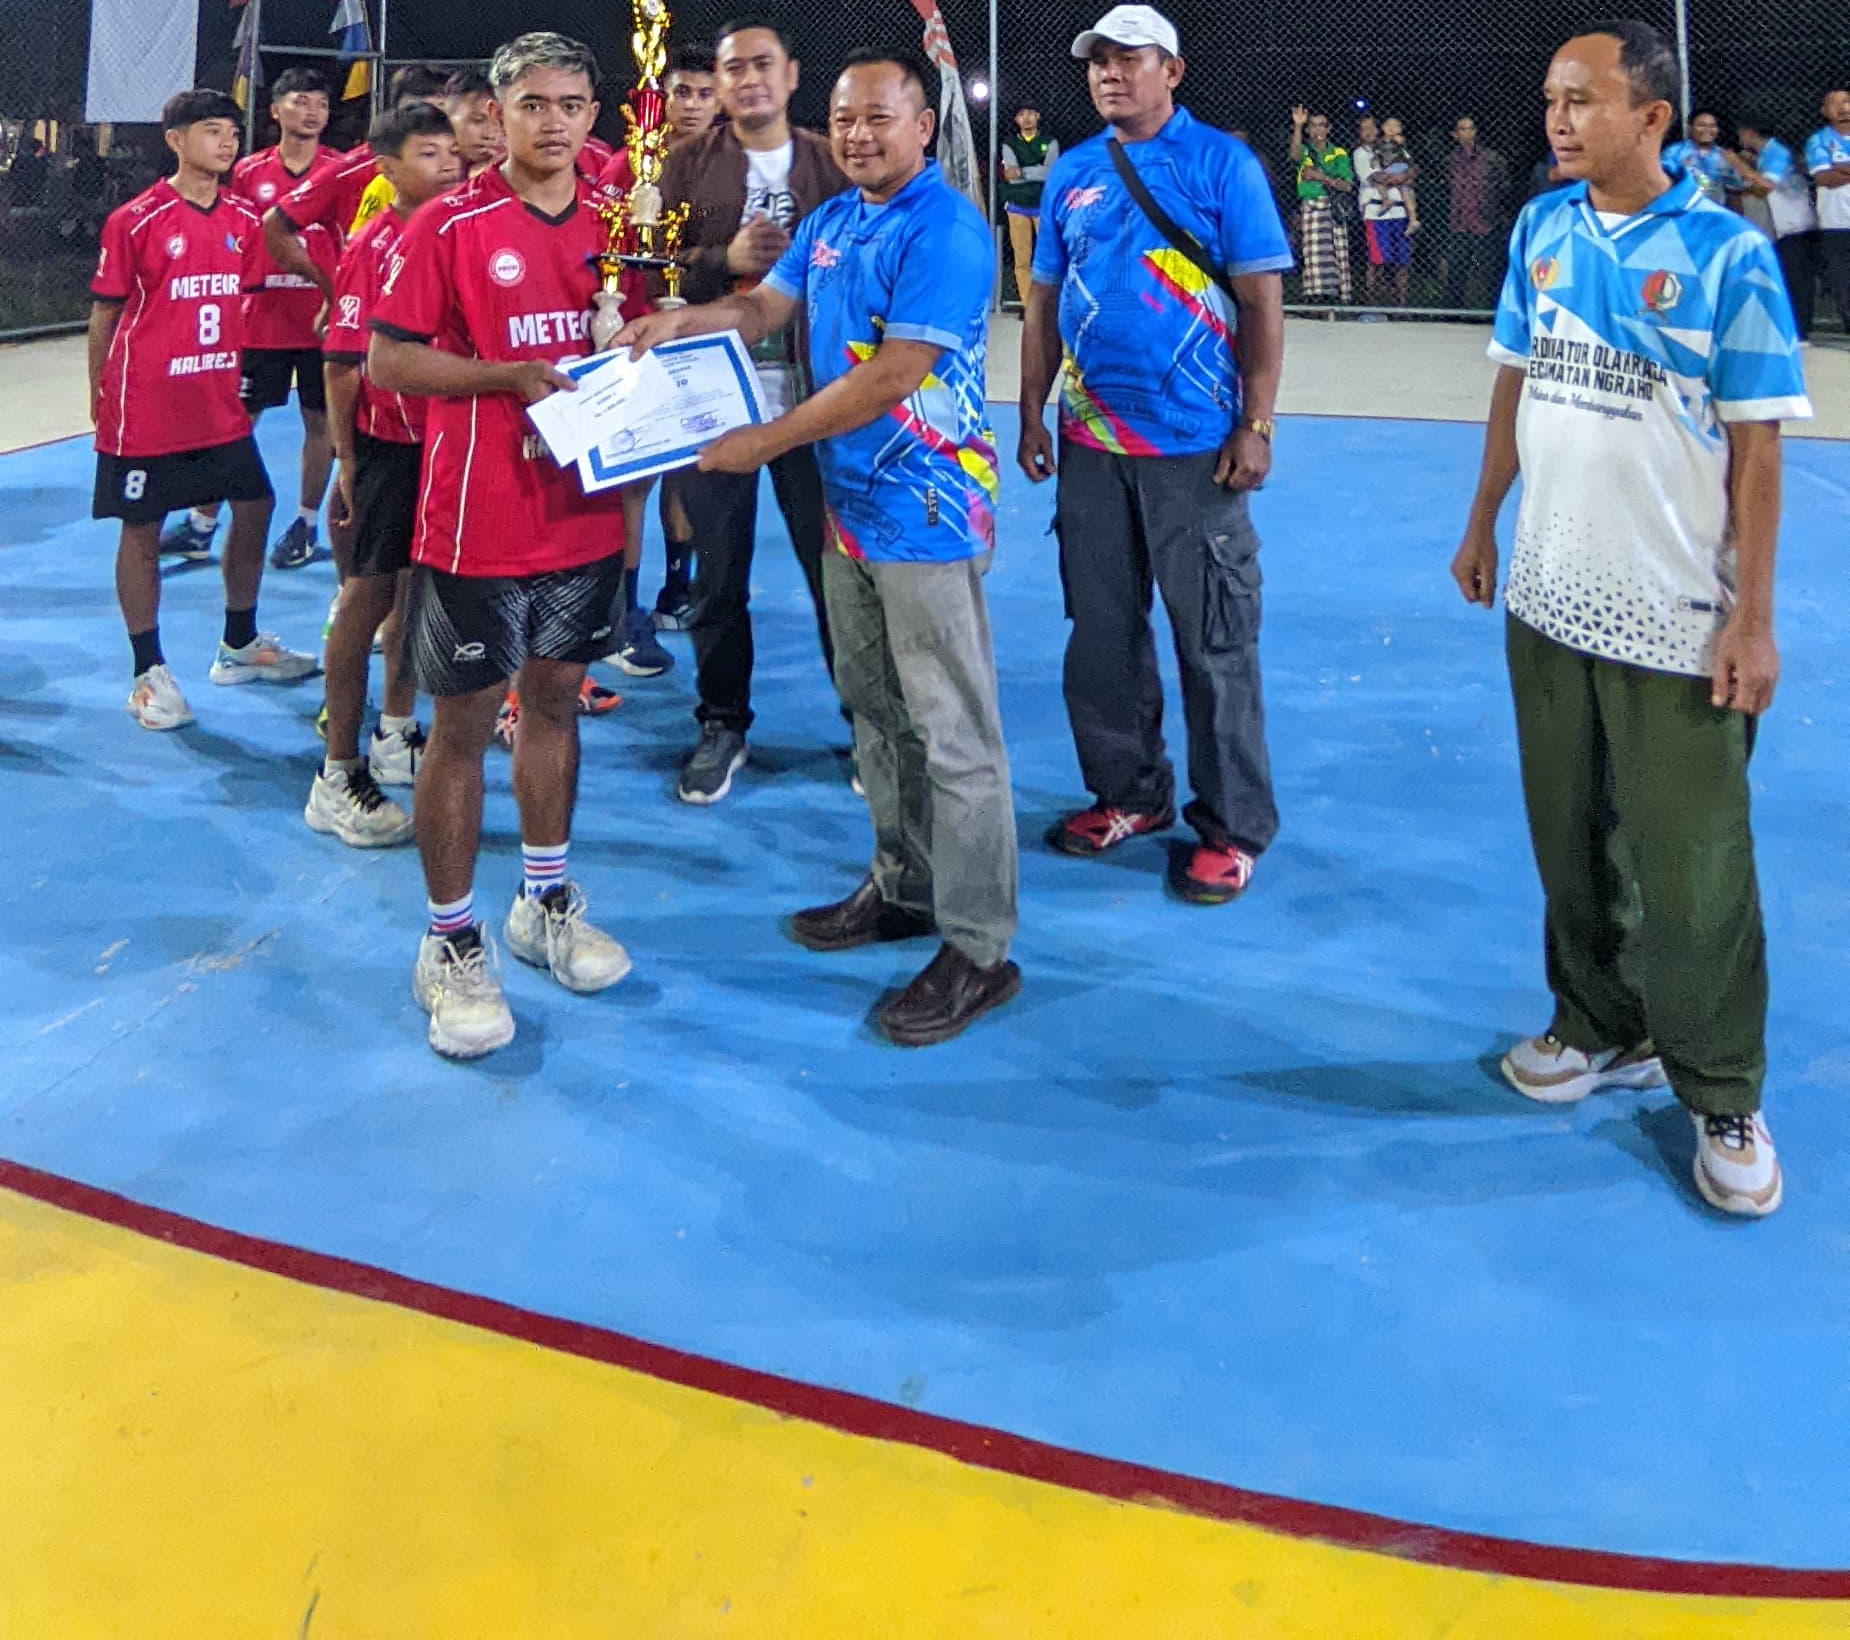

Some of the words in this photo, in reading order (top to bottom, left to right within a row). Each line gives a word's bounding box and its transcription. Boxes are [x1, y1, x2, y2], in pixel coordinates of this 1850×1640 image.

[199, 303, 221, 346] 8
[1593, 368, 1654, 401] NGRAHO
[125, 469, 148, 501] 8
